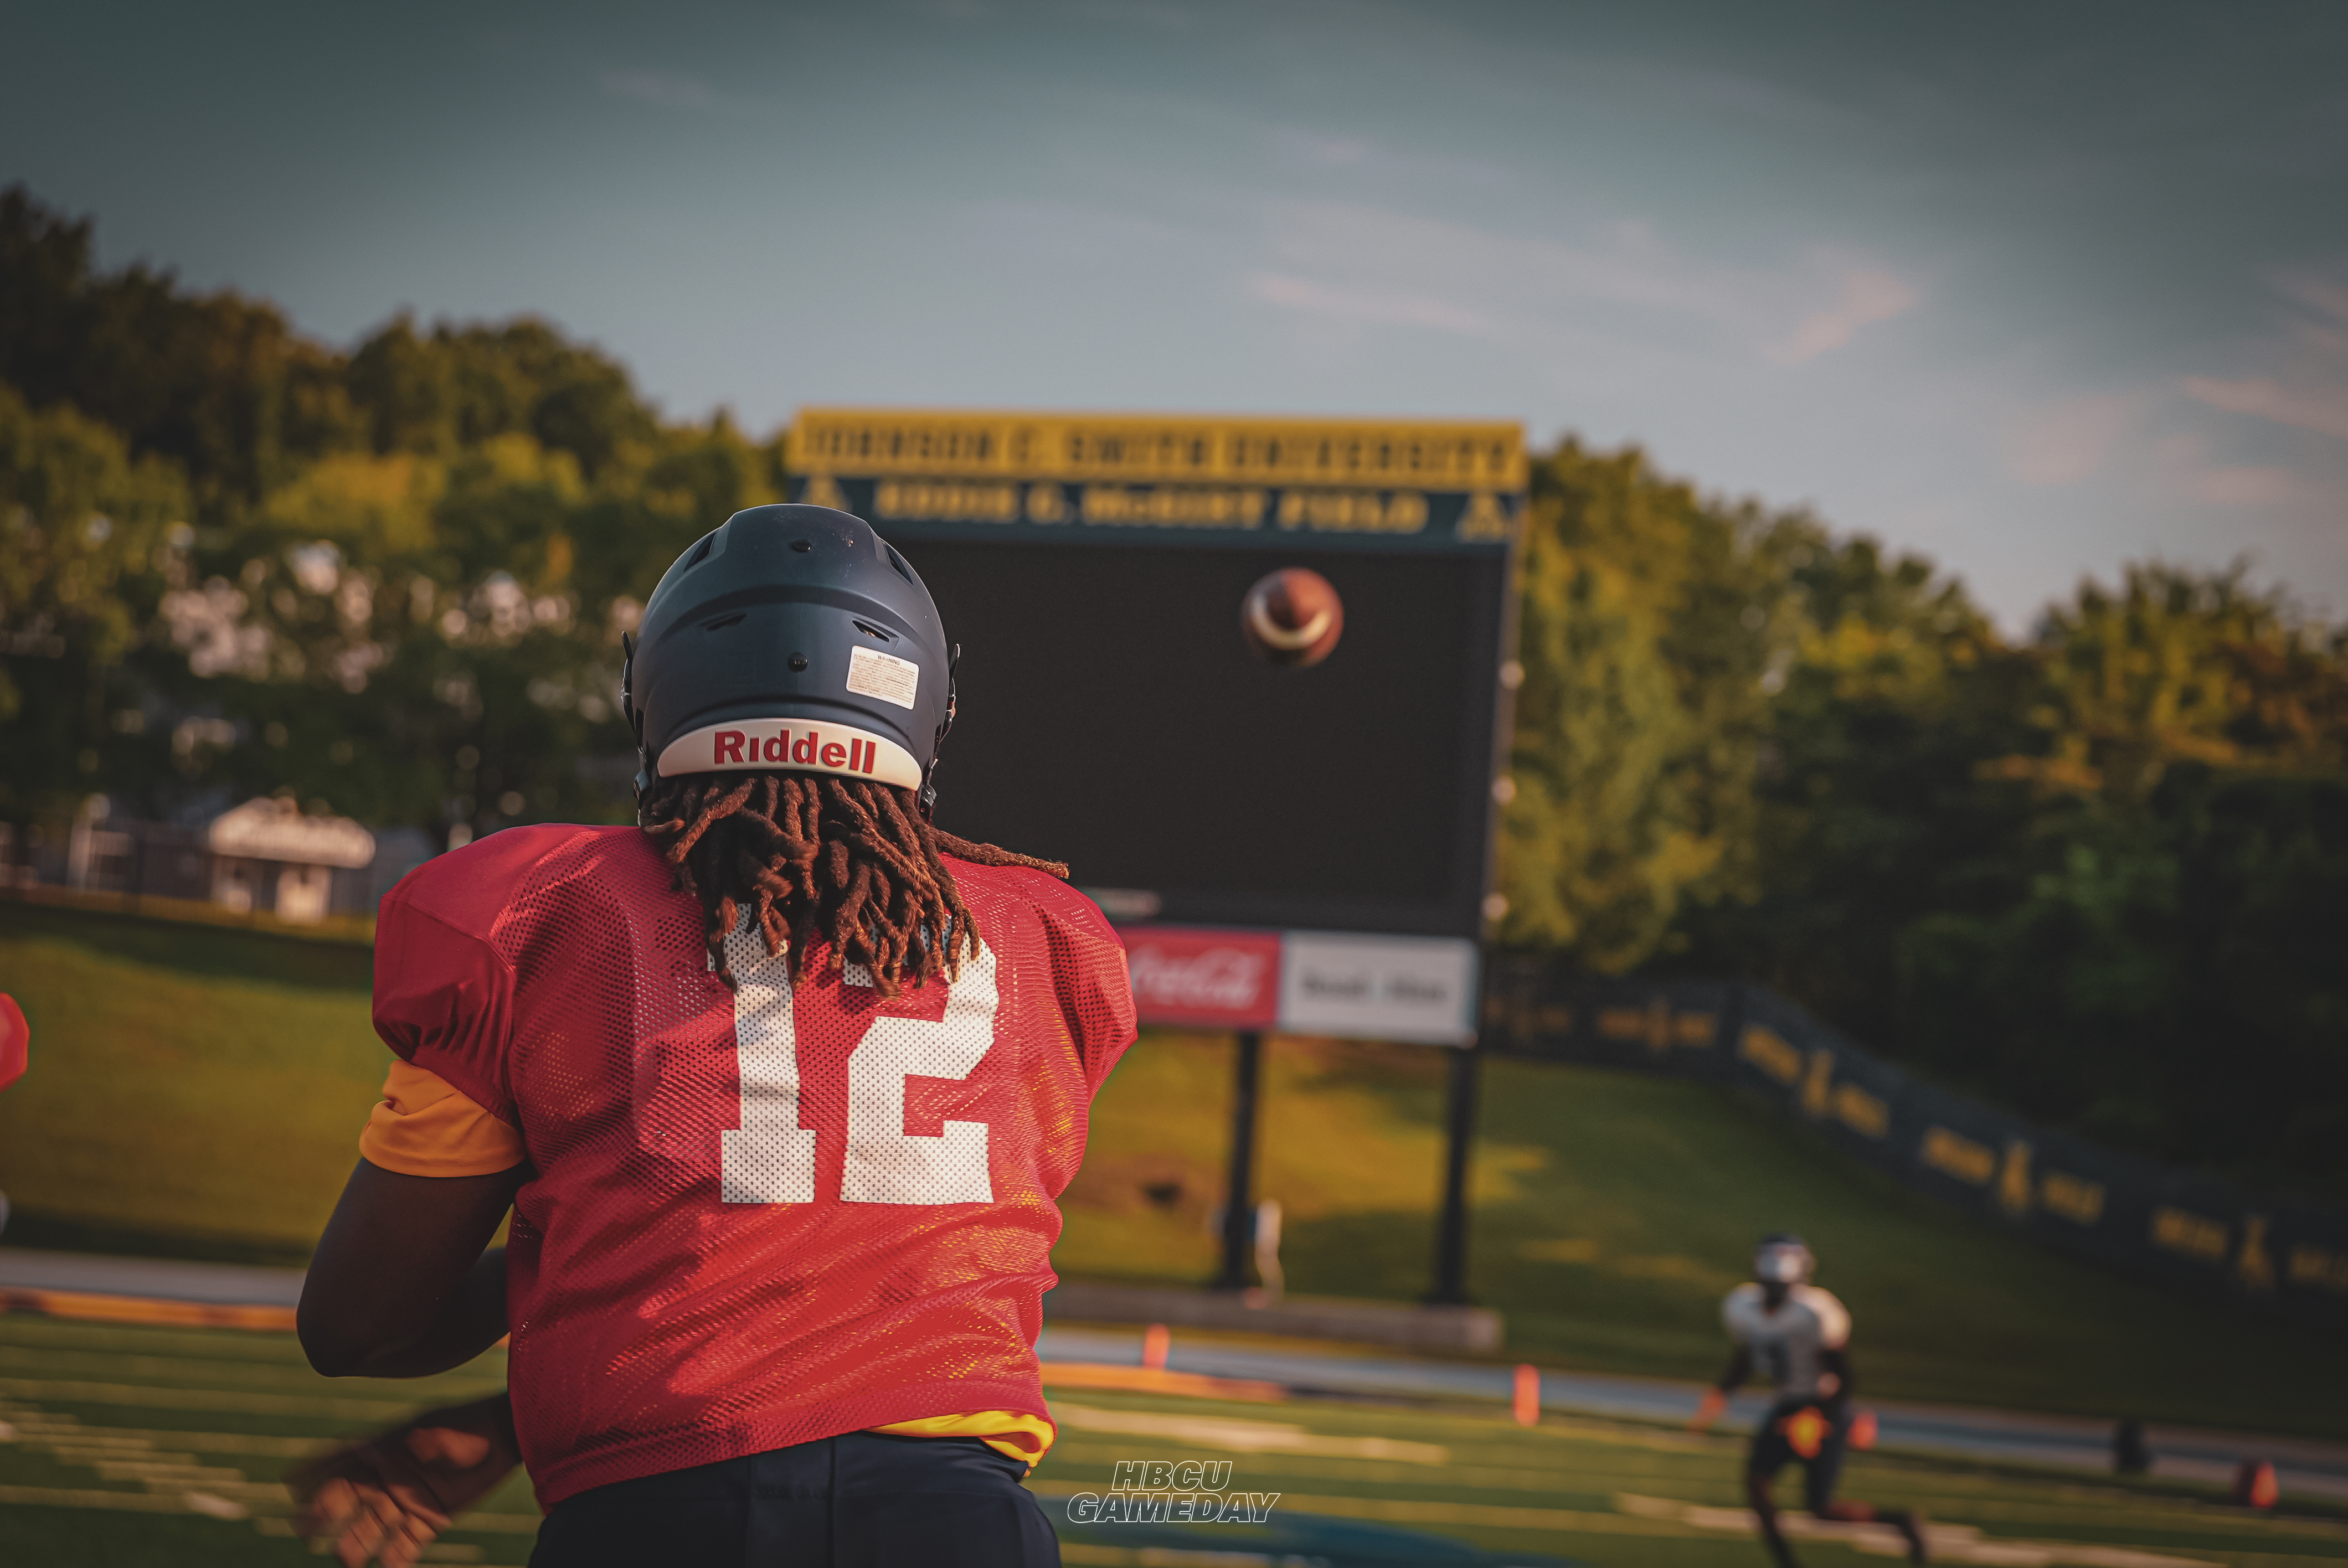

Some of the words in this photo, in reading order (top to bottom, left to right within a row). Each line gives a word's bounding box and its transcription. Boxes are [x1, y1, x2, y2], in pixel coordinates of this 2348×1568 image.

[800, 424, 997, 464] JOHNSON
[1064, 428, 1211, 470] SMITH
[1226, 433, 1513, 476] UNIVERSITY
[1280, 493, 1425, 528] FIELD
[714, 729, 876, 774] Riddell
[708, 904, 999, 1205] 12
